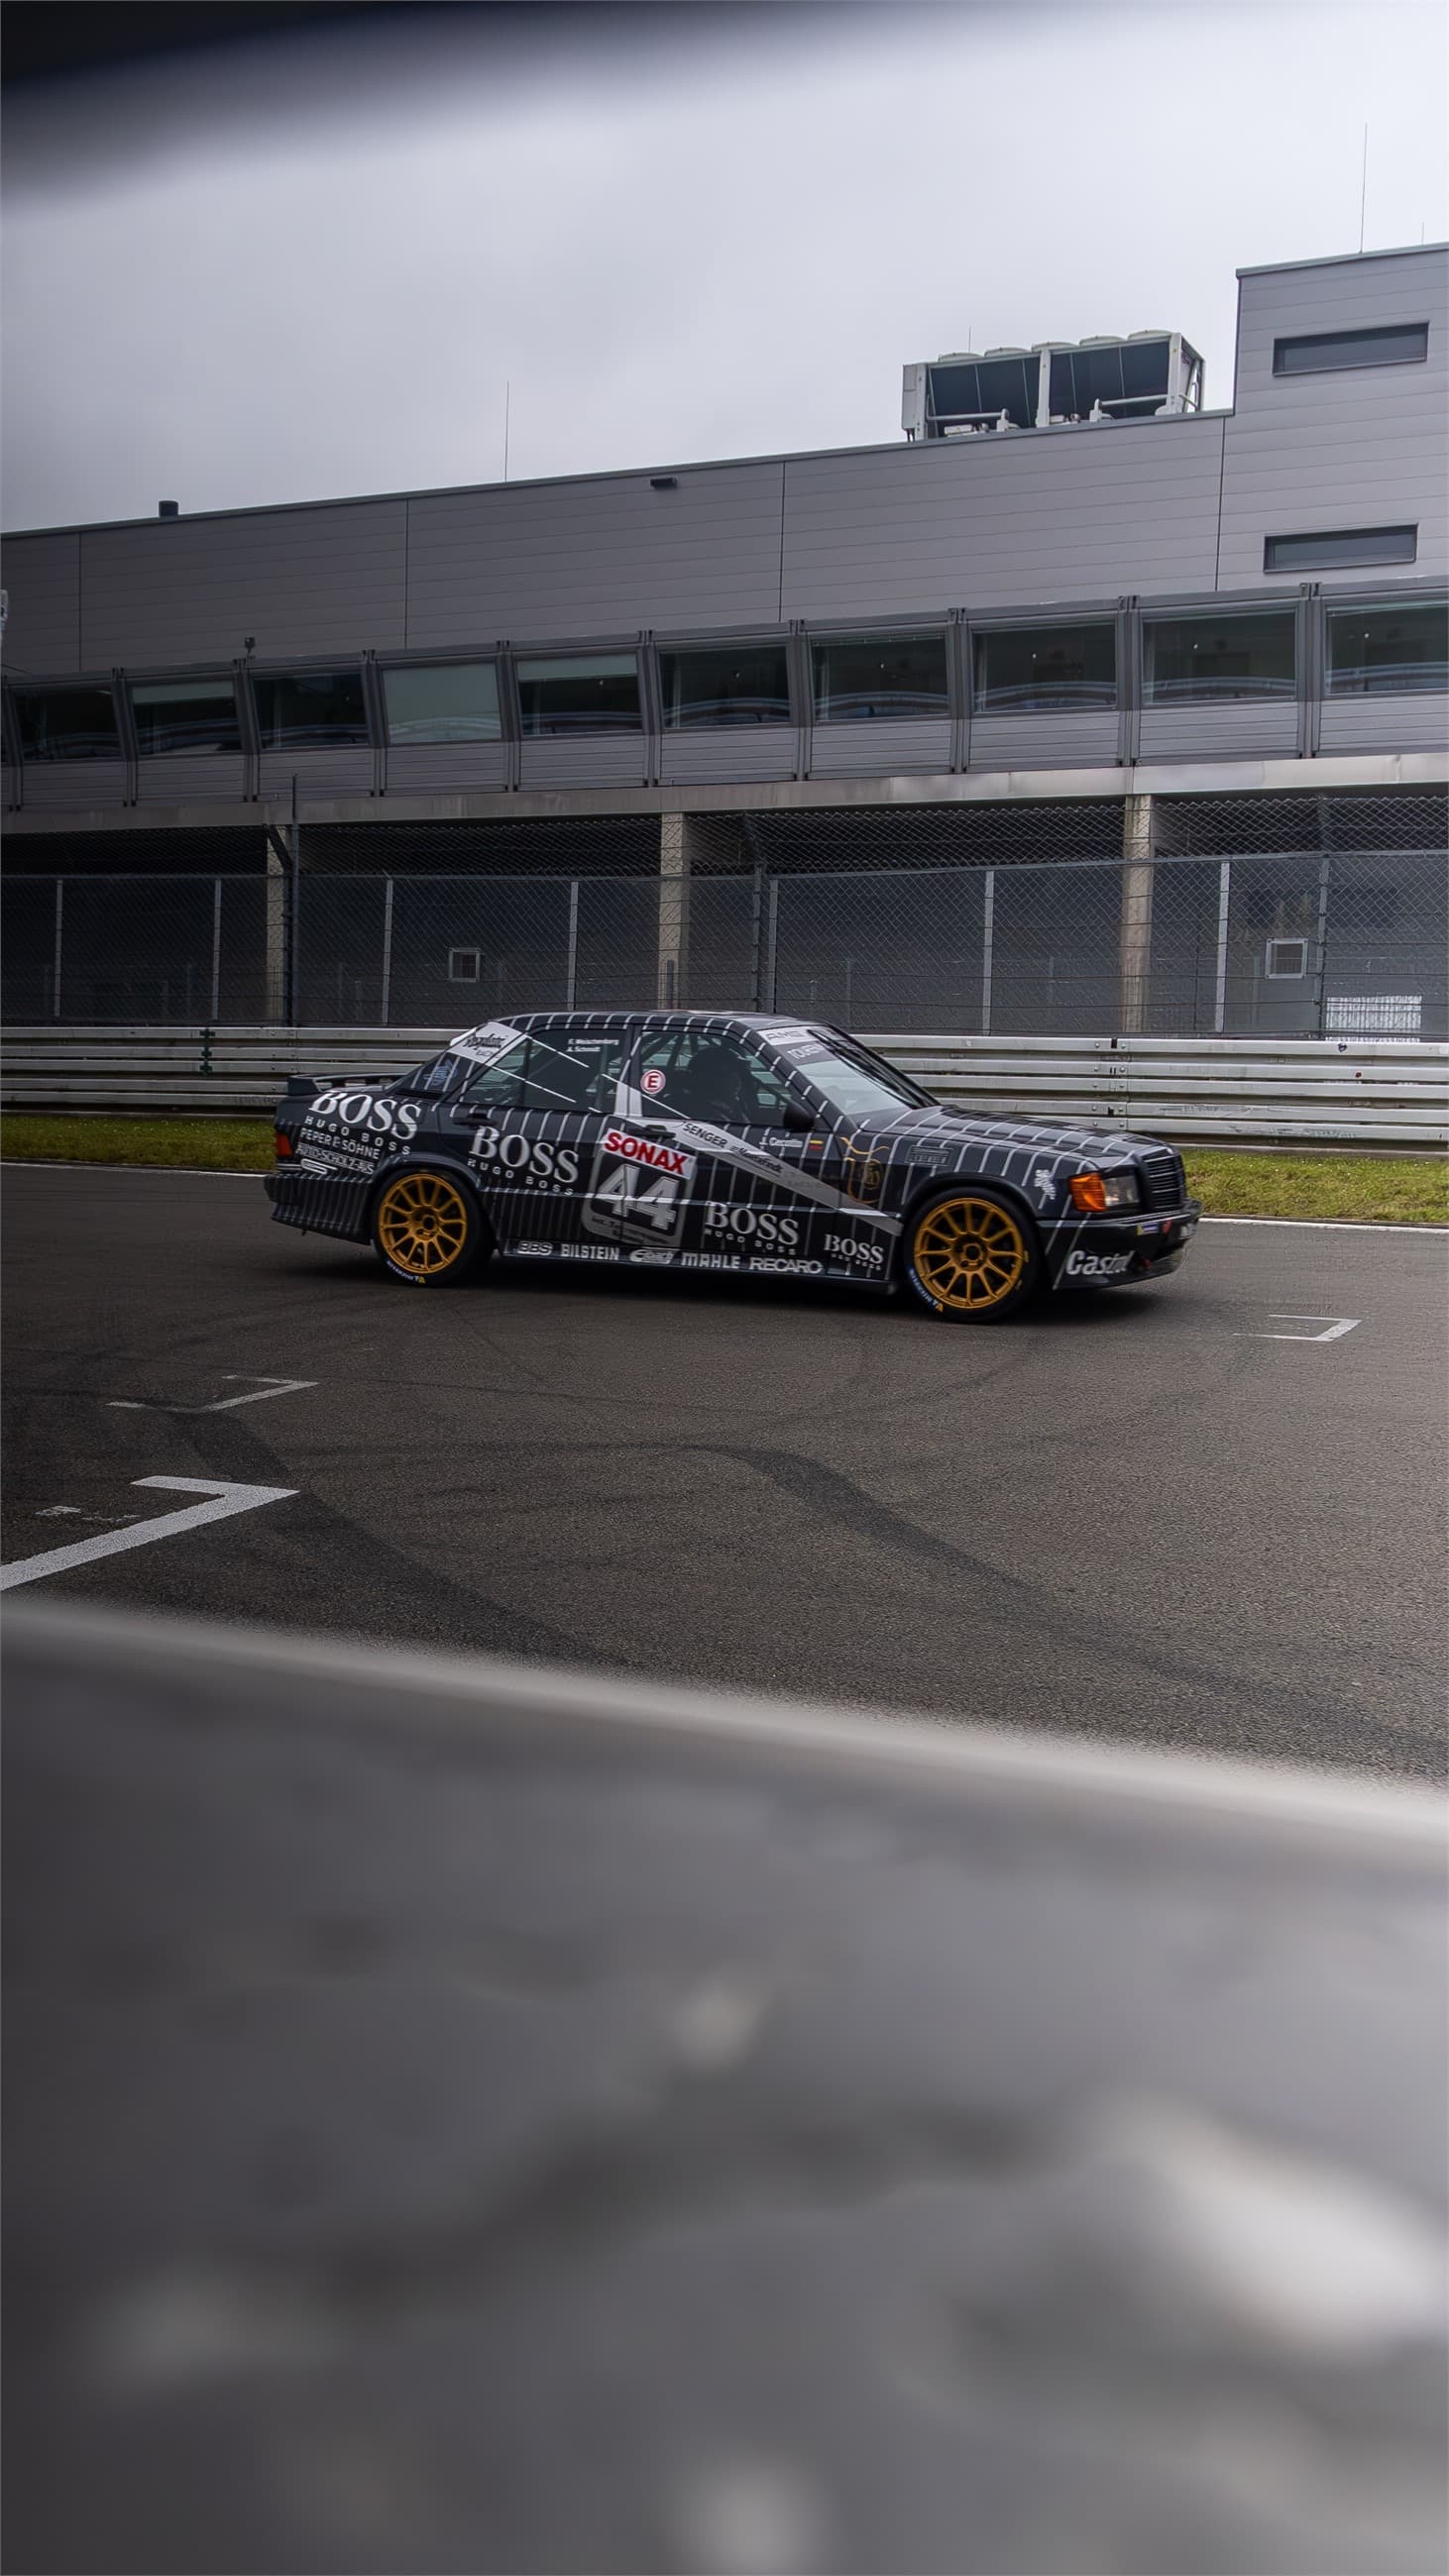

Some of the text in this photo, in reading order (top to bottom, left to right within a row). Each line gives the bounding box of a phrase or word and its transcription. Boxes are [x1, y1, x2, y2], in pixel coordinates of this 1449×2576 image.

[647, 1075, 658, 1089] E
[309, 1091, 421, 1140] BOSS
[300, 1127, 332, 1145] PEPER
[304, 1116, 410, 1155] HUGO BOSS
[683, 1123, 728, 1148] SENGER
[469, 1126, 579, 1184] BOSS
[605, 1131, 687, 1175] SONAX
[468, 1158, 574, 1196] HUGO BOSS
[598, 1163, 680, 1231] 44
[705, 1201, 799, 1245] BOSS
[517, 1240, 553, 1256] BBS
[560, 1243, 619, 1261] BILSTEIN
[681, 1251, 741, 1269] MAHLE
[824, 1234, 884, 1264] BOSS
[748, 1256, 822, 1274] RECARO
